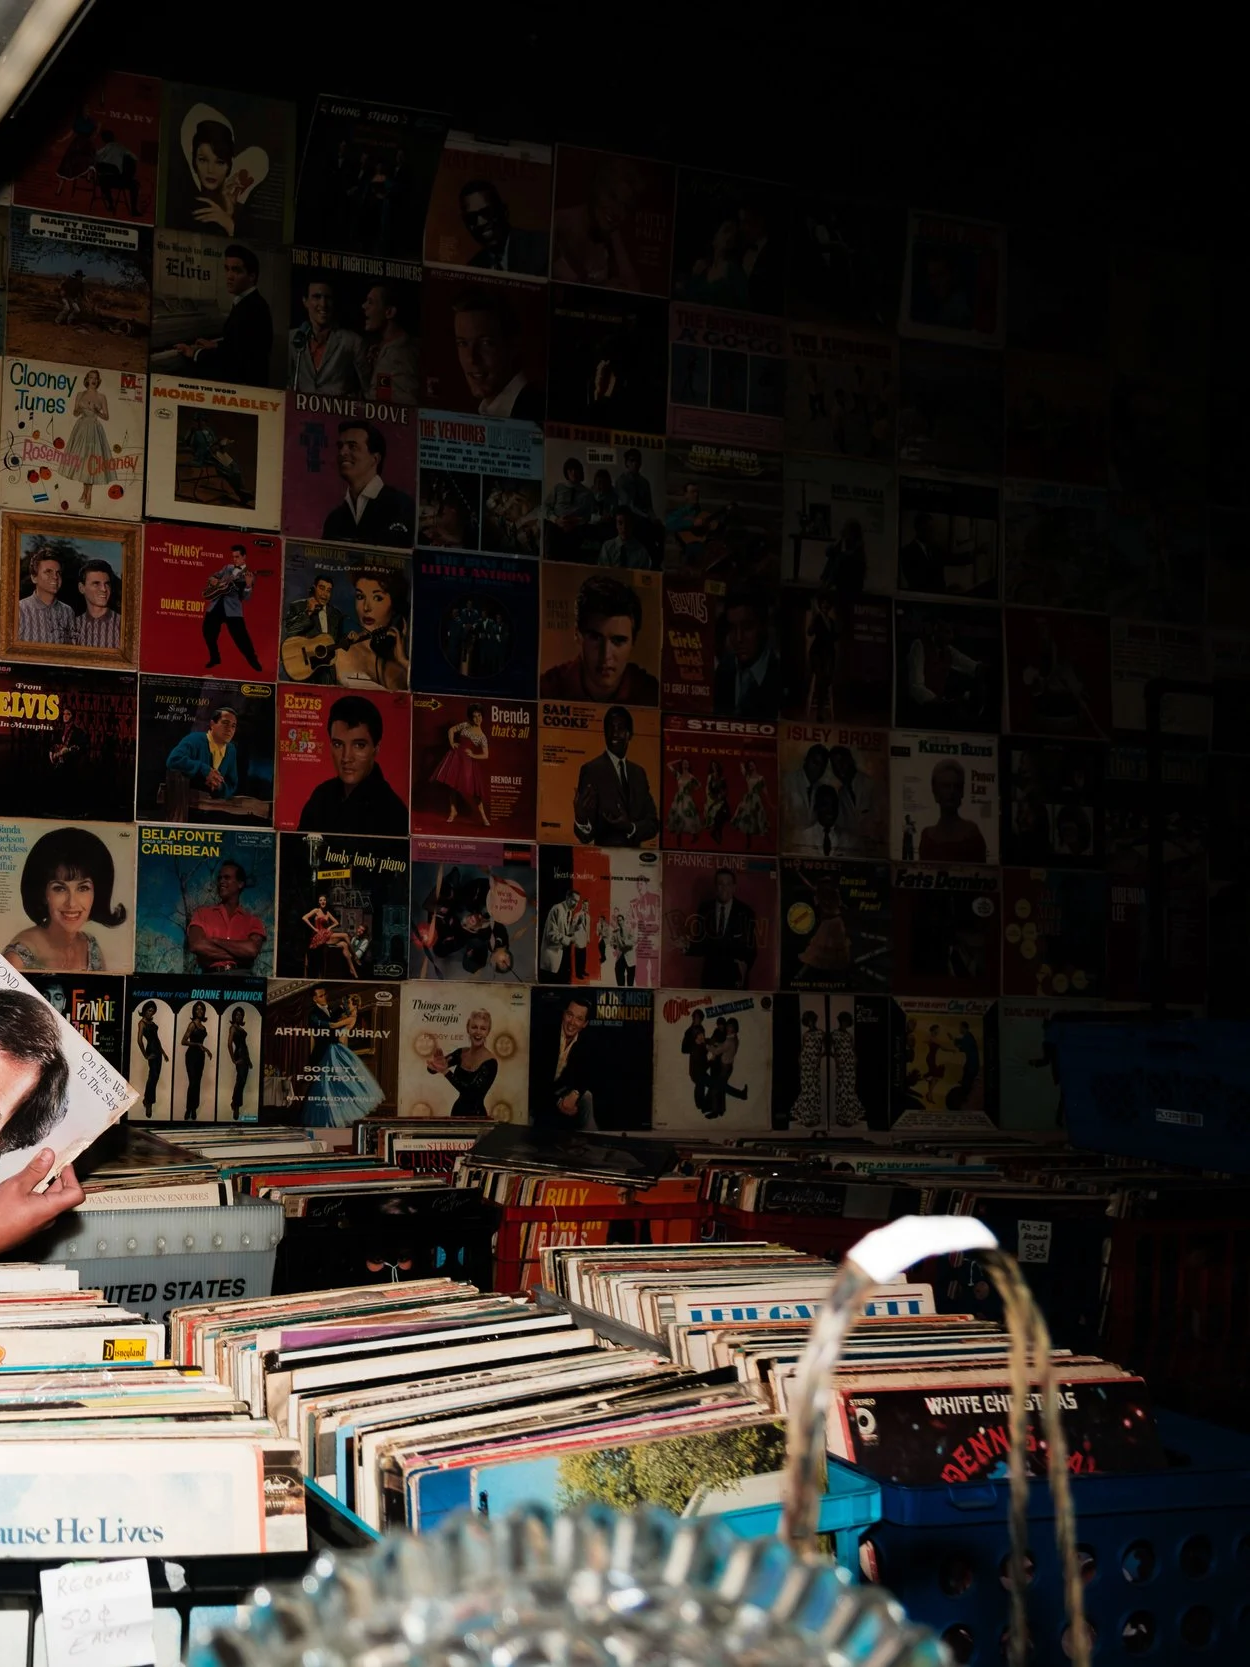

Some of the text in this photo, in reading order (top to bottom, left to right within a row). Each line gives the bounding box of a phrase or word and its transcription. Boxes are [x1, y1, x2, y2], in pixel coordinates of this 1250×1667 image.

[40, 217, 129, 237] MARTY ROBBINS
[68, 226, 106, 239] RETURN
[32, 229, 136, 249] OF THE GUNFIGHTER
[166, 257, 211, 281] Elvis
[292, 248, 309, 265] THIS
[312, 251, 319, 266] IS
[343, 255, 383, 275] RIGHTEOUS
[386, 265, 422, 282] BROTHERS
[11, 362, 77, 397] Clooney
[15, 390, 66, 414] Tunes
[152, 387, 280, 412] MOMS MABLEY
[295, 394, 409, 424] RONNIE DOVE
[420, 419, 486, 442] THE VENTURES
[150, 545, 167, 554] HAVE
[200, 550, 223, 559] GUITAR
[160, 598, 206, 613] DUANE EDDY
[15, 683, 42, 691] From
[154, 695, 210, 706] PERRY COMO
[284, 694, 322, 711] ELVIS
[492, 705, 530, 724] Brenda
[543, 703, 571, 716] SAM
[543, 715, 588, 728] COOKE
[687, 719, 775, 735] STEREO
[142, 830, 222, 842] BELAFONTE
[142, 844, 220, 857] CARIBBEAN
[325, 847, 351, 865] honky
[379, 858, 406, 873] piano
[667, 854, 746, 870] FRANKIE LAINE
[191, 989, 263, 1001] DIONNE WARWICK
[412, 1001, 457, 1013] Things are
[597, 1006, 652, 1021] MOONLIGHT
[275, 1027, 391, 1039] ARTHUR MURRAY
[81, 1051, 130, 1102] On The Way
[303, 1065, 358, 1073] SOCIETY
[297, 1074, 322, 1082] FOX
[77, 1066, 119, 1111] To The Sky
[168, 1192, 209, 1201] ENCORES
[547, 1186, 589, 1205] BILLY
[79, 1278, 246, 1303] ITED STATES
[104, 1339, 147, 1360] Disneyland
[926, 1396, 981, 1416] WHITE
[56, 1517, 95, 1544] He
[99, 1516, 164, 1545] Lives
